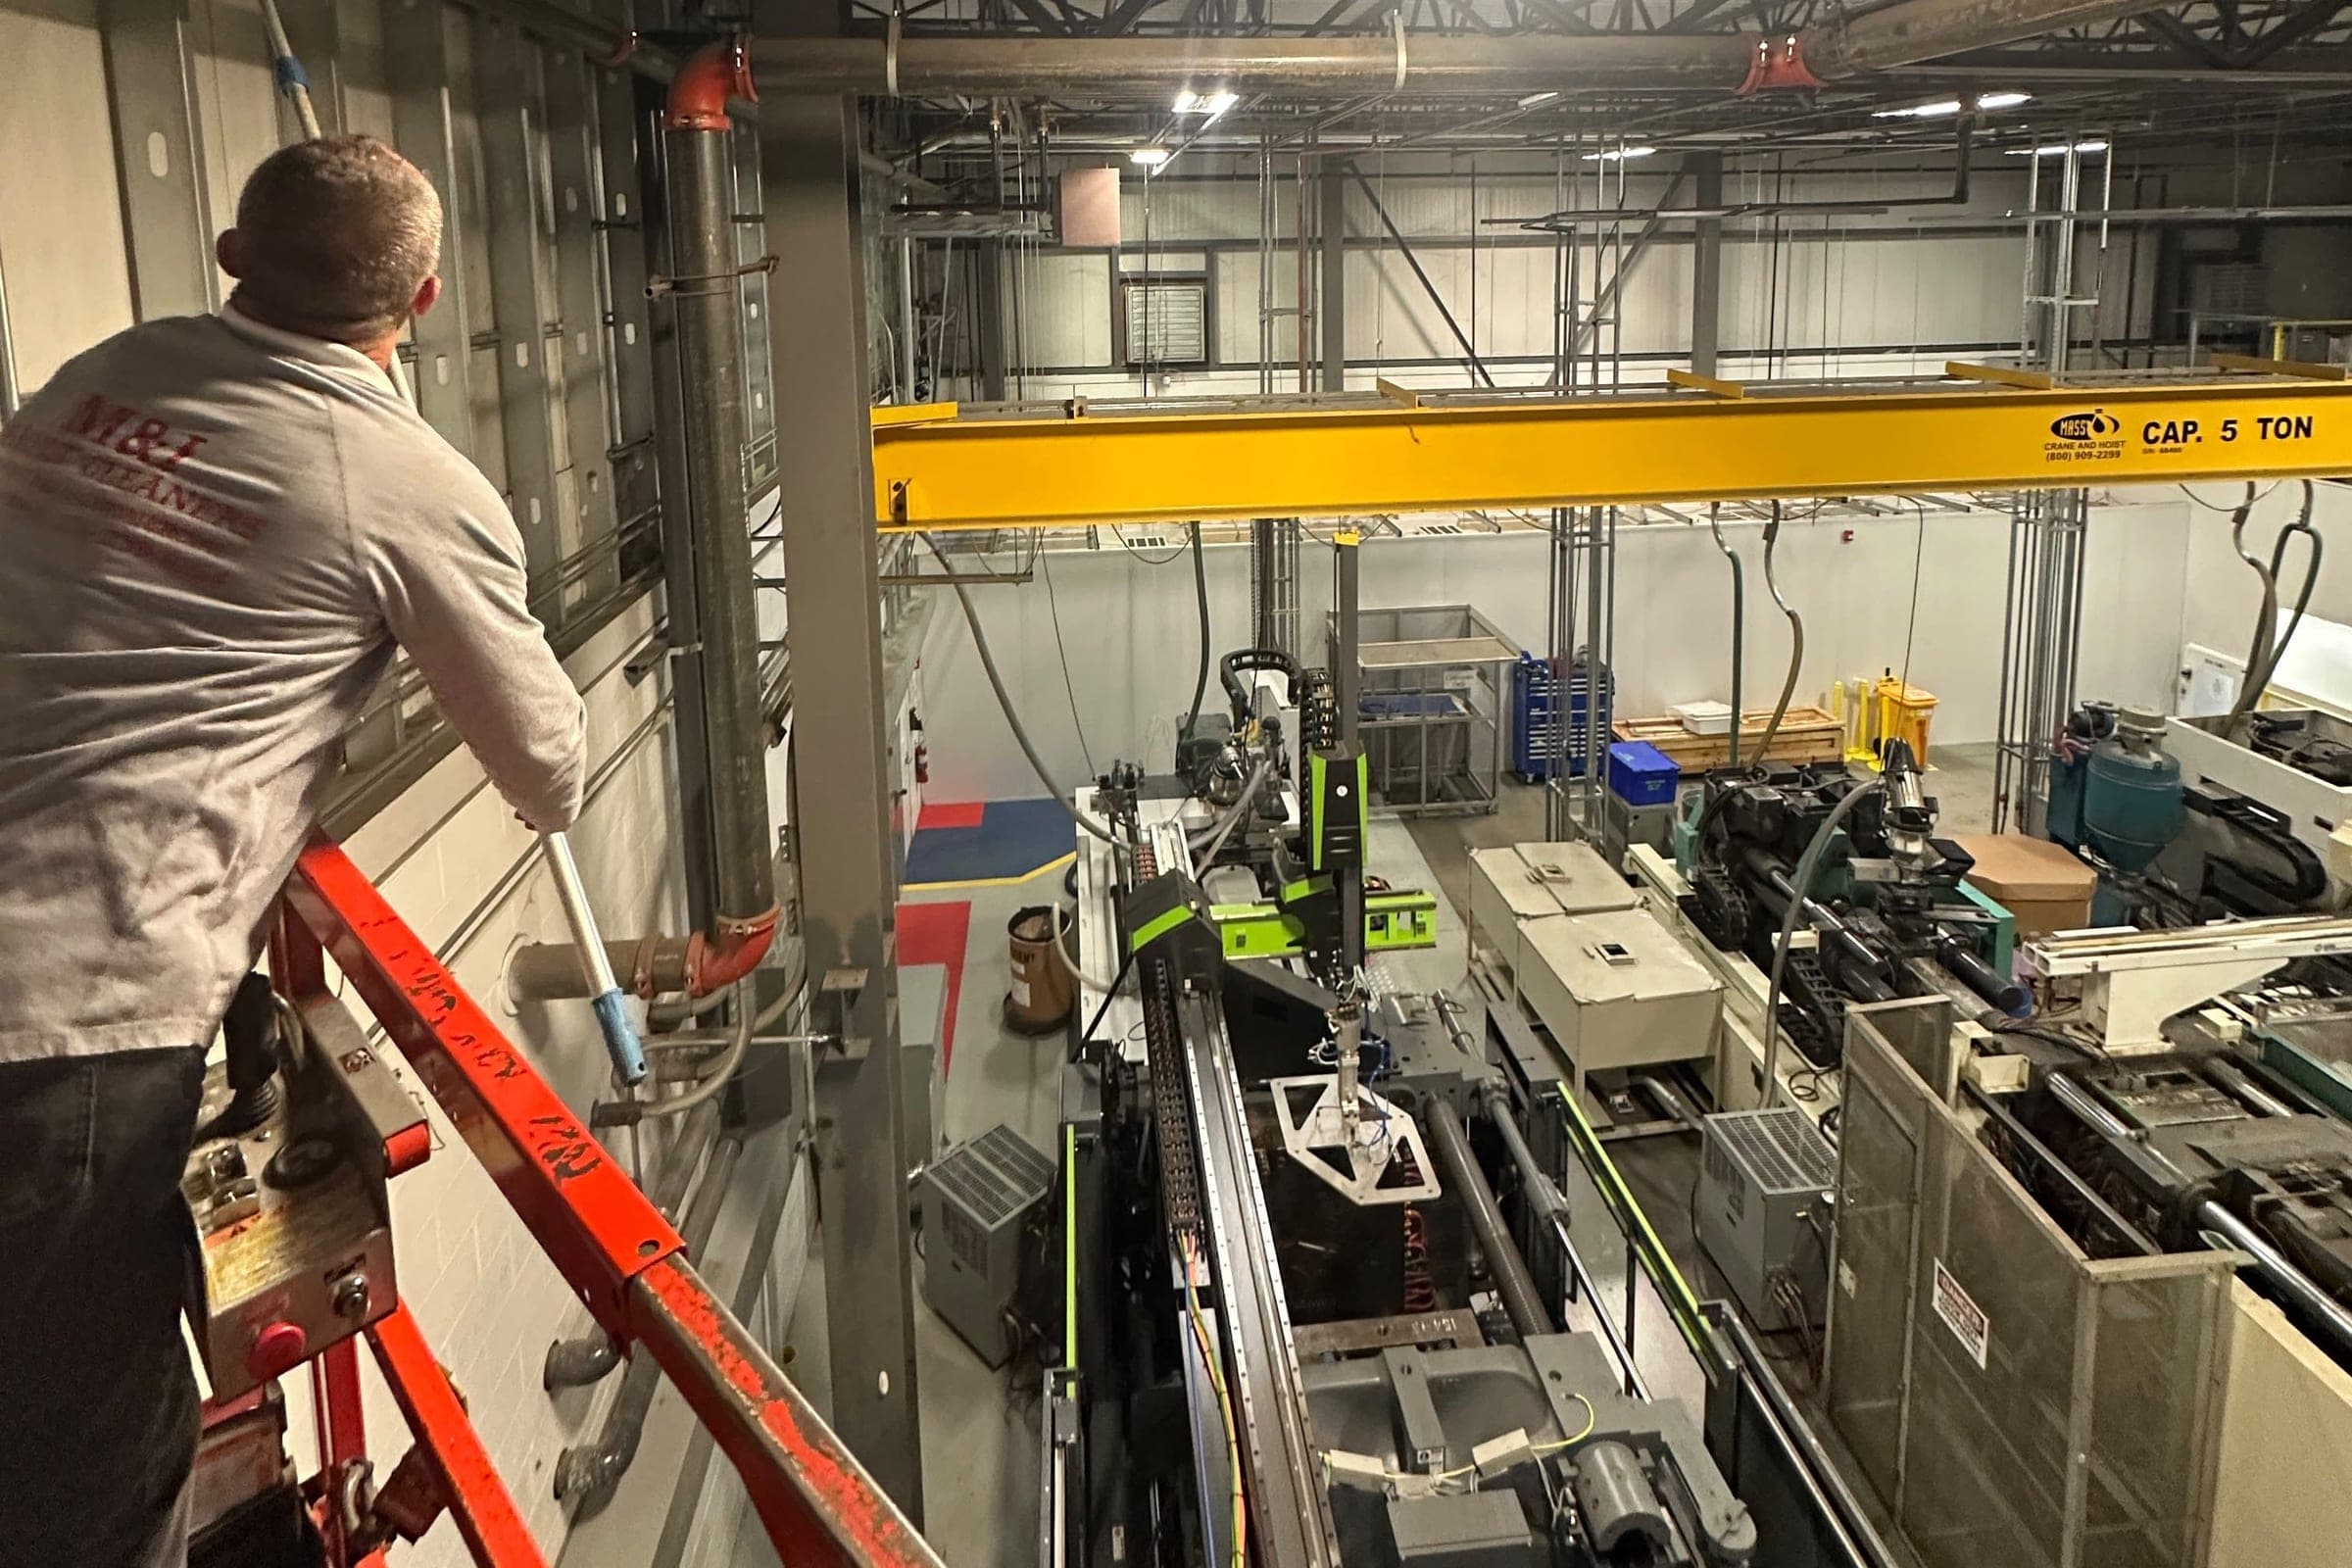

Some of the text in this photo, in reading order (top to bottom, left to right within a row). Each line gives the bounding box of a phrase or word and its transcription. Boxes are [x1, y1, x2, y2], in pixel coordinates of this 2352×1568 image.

[2060, 419, 2086, 436] MASS
[2142, 416, 2313, 444] CAP. 5 TON
[2044, 442, 2077, 451] CRANE
[2098, 440, 2126, 449] HOIST
[2046, 450, 2121, 462] (800) 909-2299
